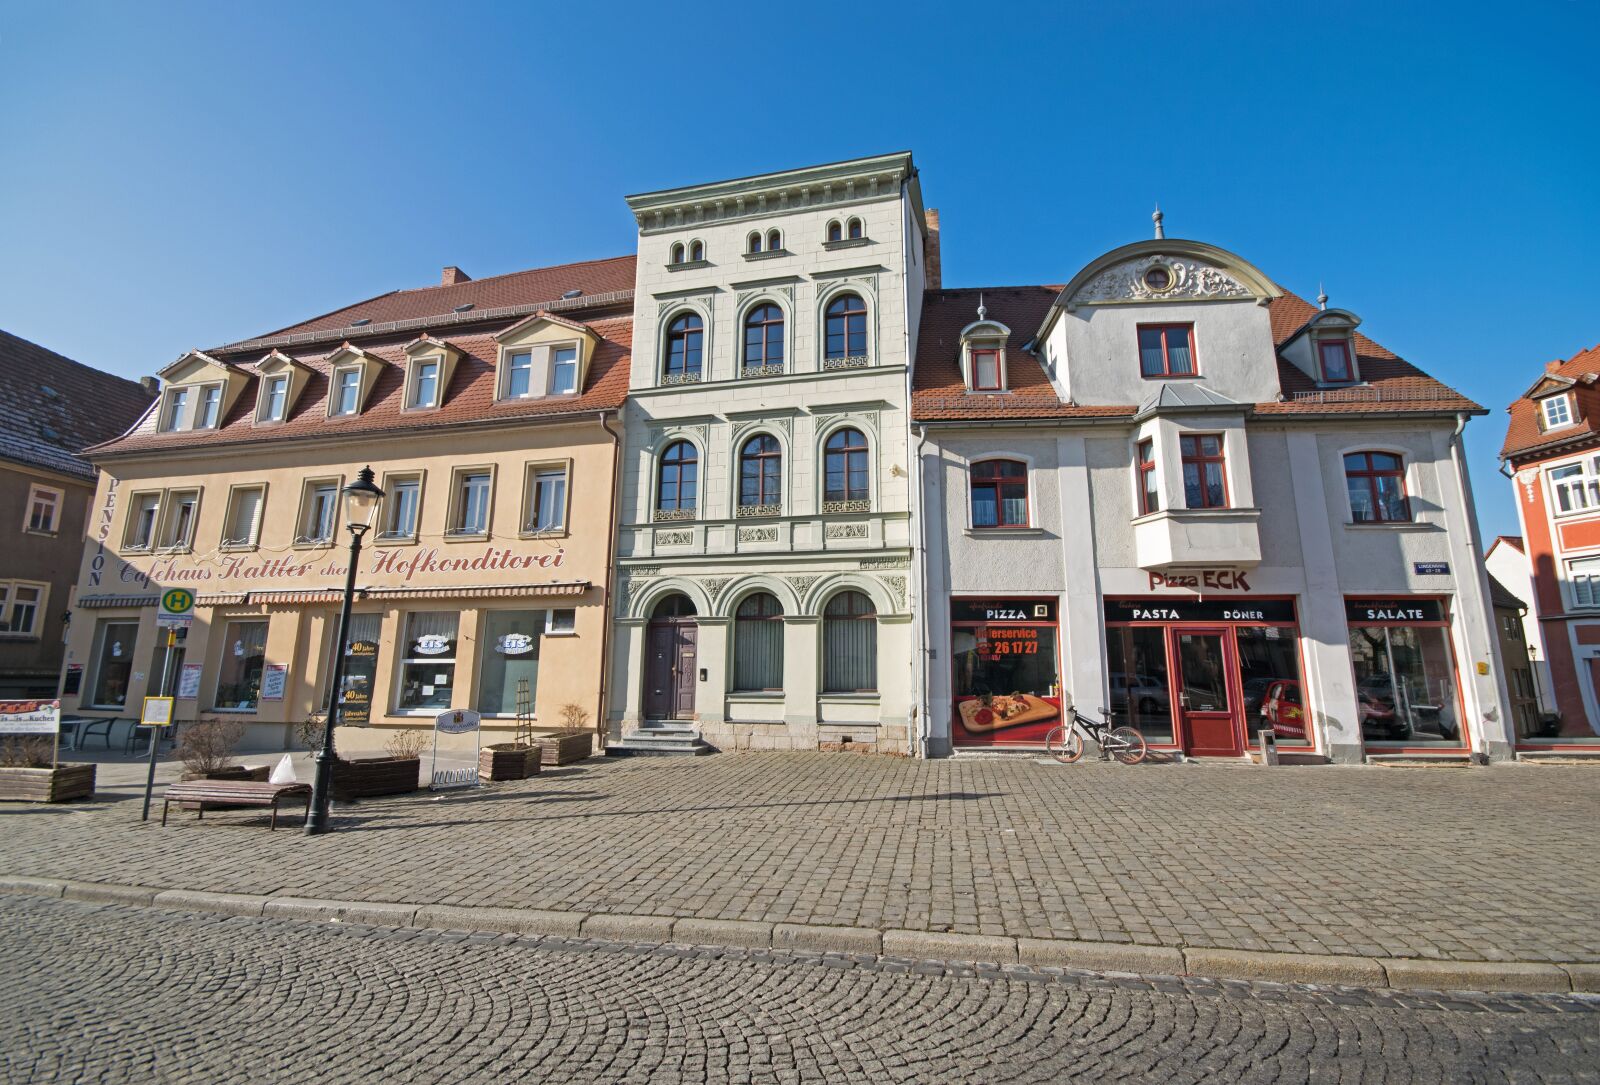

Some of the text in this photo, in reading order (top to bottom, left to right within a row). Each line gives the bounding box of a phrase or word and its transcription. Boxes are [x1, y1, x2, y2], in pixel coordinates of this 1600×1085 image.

[88, 479, 120, 586] PENSION
[371, 548, 565, 581] Hofkonditorei
[1149, 571, 1251, 592] Pizza ECK
[986, 609, 1027, 619] PIZZA
[1133, 609, 1180, 619] PASTA
[1223, 610, 1264, 619] DÖNER
[1367, 609, 1424, 619] SALATE
[975, 629, 1037, 639] Lieferservice
[352, 642, 363, 651] 40
[994, 641, 1038, 654] 26 17 27
[345, 690, 356, 700] 40
